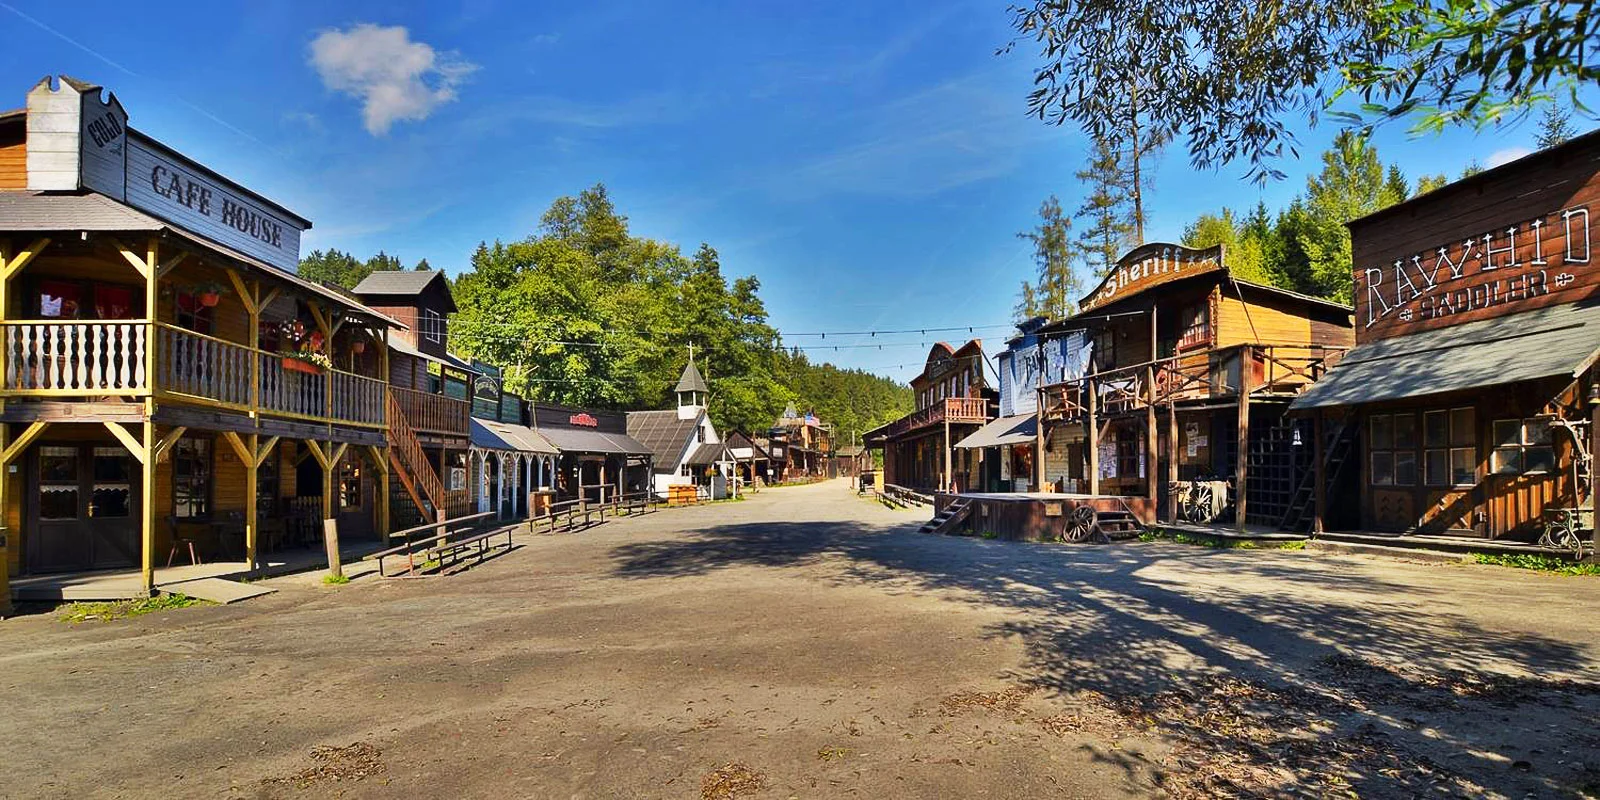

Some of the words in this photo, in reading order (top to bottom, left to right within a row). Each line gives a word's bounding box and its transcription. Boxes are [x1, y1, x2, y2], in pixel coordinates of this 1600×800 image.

[87, 112, 122, 148] GOLD
[151, 165, 212, 216] CAFE
[221, 198, 283, 249] HOUSE
[1104, 247, 1183, 298] Sheriff
[1420, 270, 1550, 319] SADDLER
